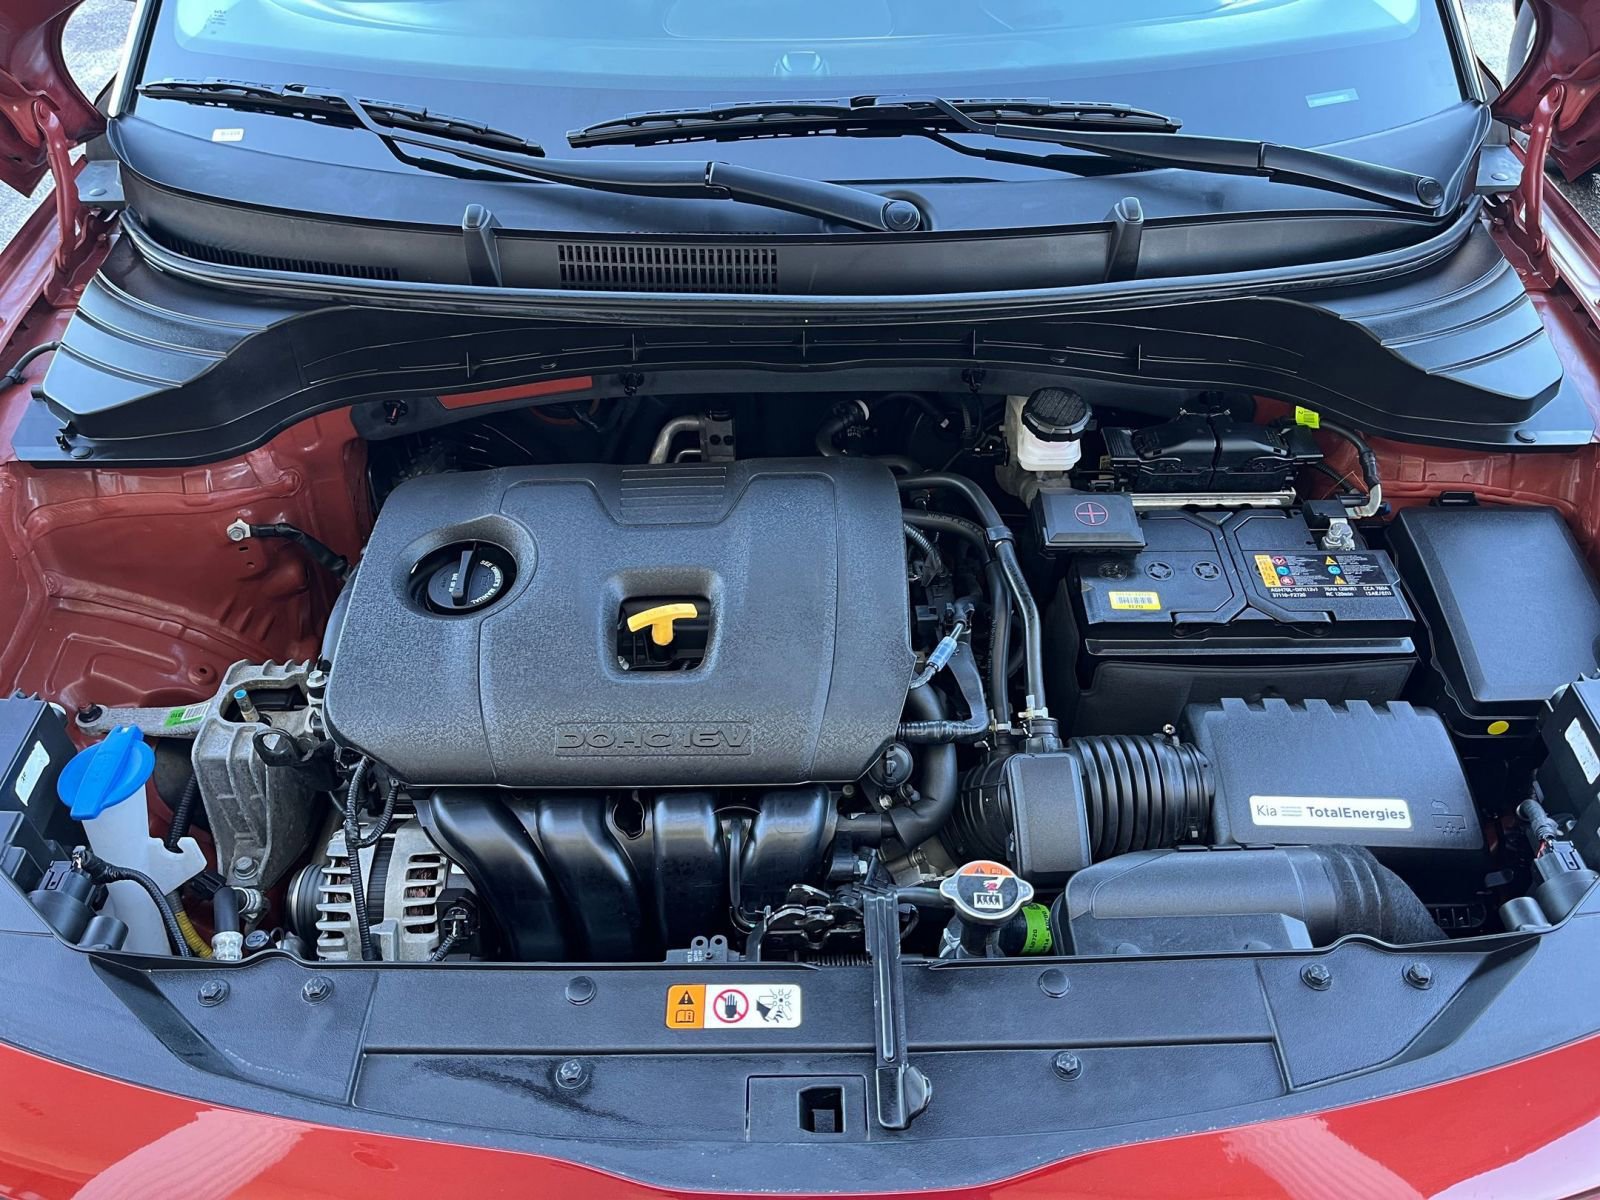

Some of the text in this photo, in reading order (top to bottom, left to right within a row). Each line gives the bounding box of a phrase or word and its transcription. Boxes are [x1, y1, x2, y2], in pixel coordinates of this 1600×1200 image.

[479, 559, 493, 568] SEE
[470, 587, 497, 605] MANUAL
[557, 729, 750, 749] DOHC 16V
[1256, 804, 1406, 821] Kia TotalEnergies
